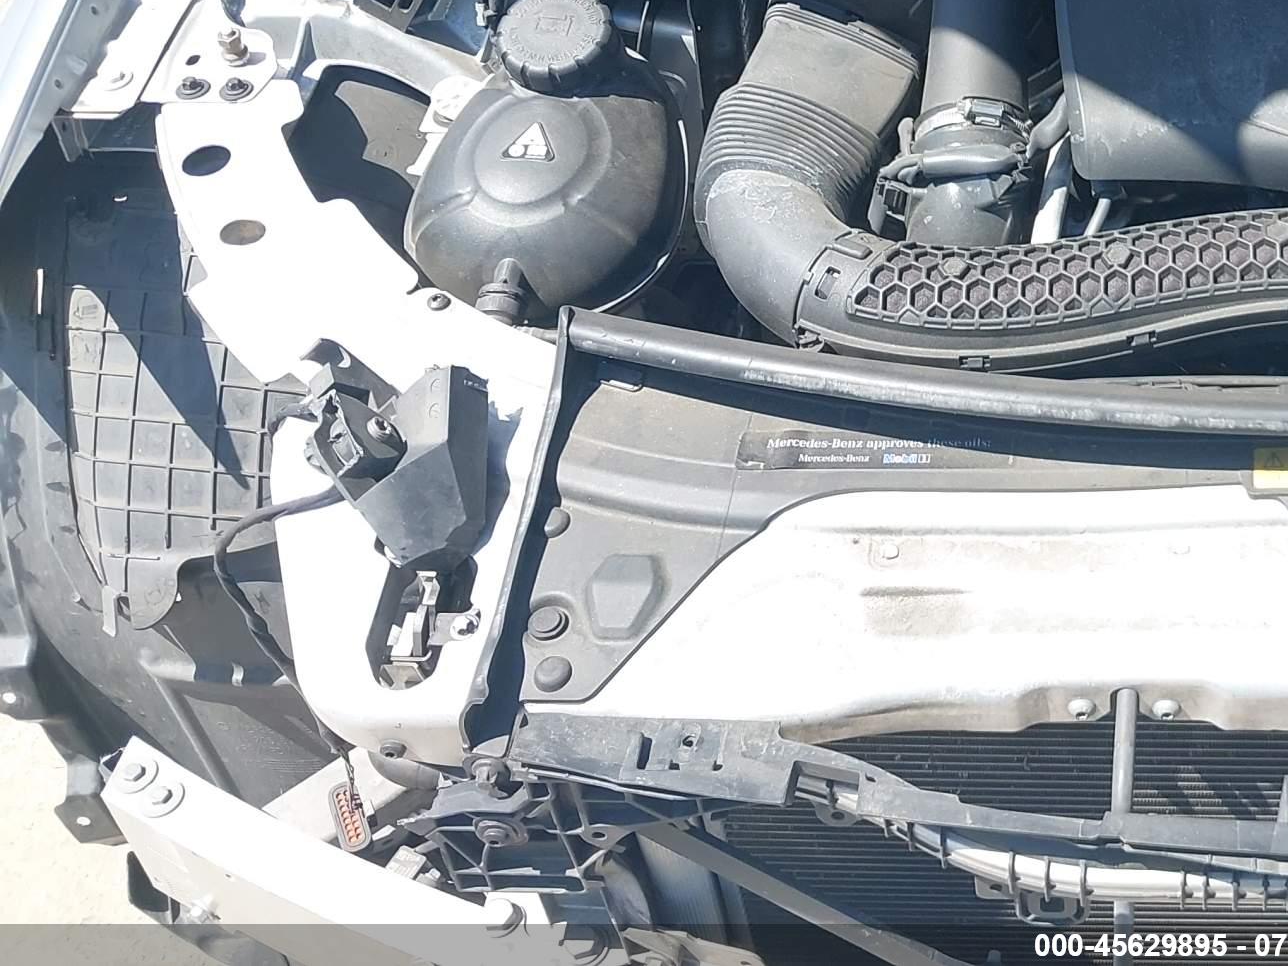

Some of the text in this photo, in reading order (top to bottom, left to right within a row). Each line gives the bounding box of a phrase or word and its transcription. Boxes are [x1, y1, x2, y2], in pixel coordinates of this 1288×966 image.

[767, 437, 864, 449] Mercedes-Benz
[866, 439, 924, 451] approves
[798, 453, 870, 463] Mercedes-Benz
